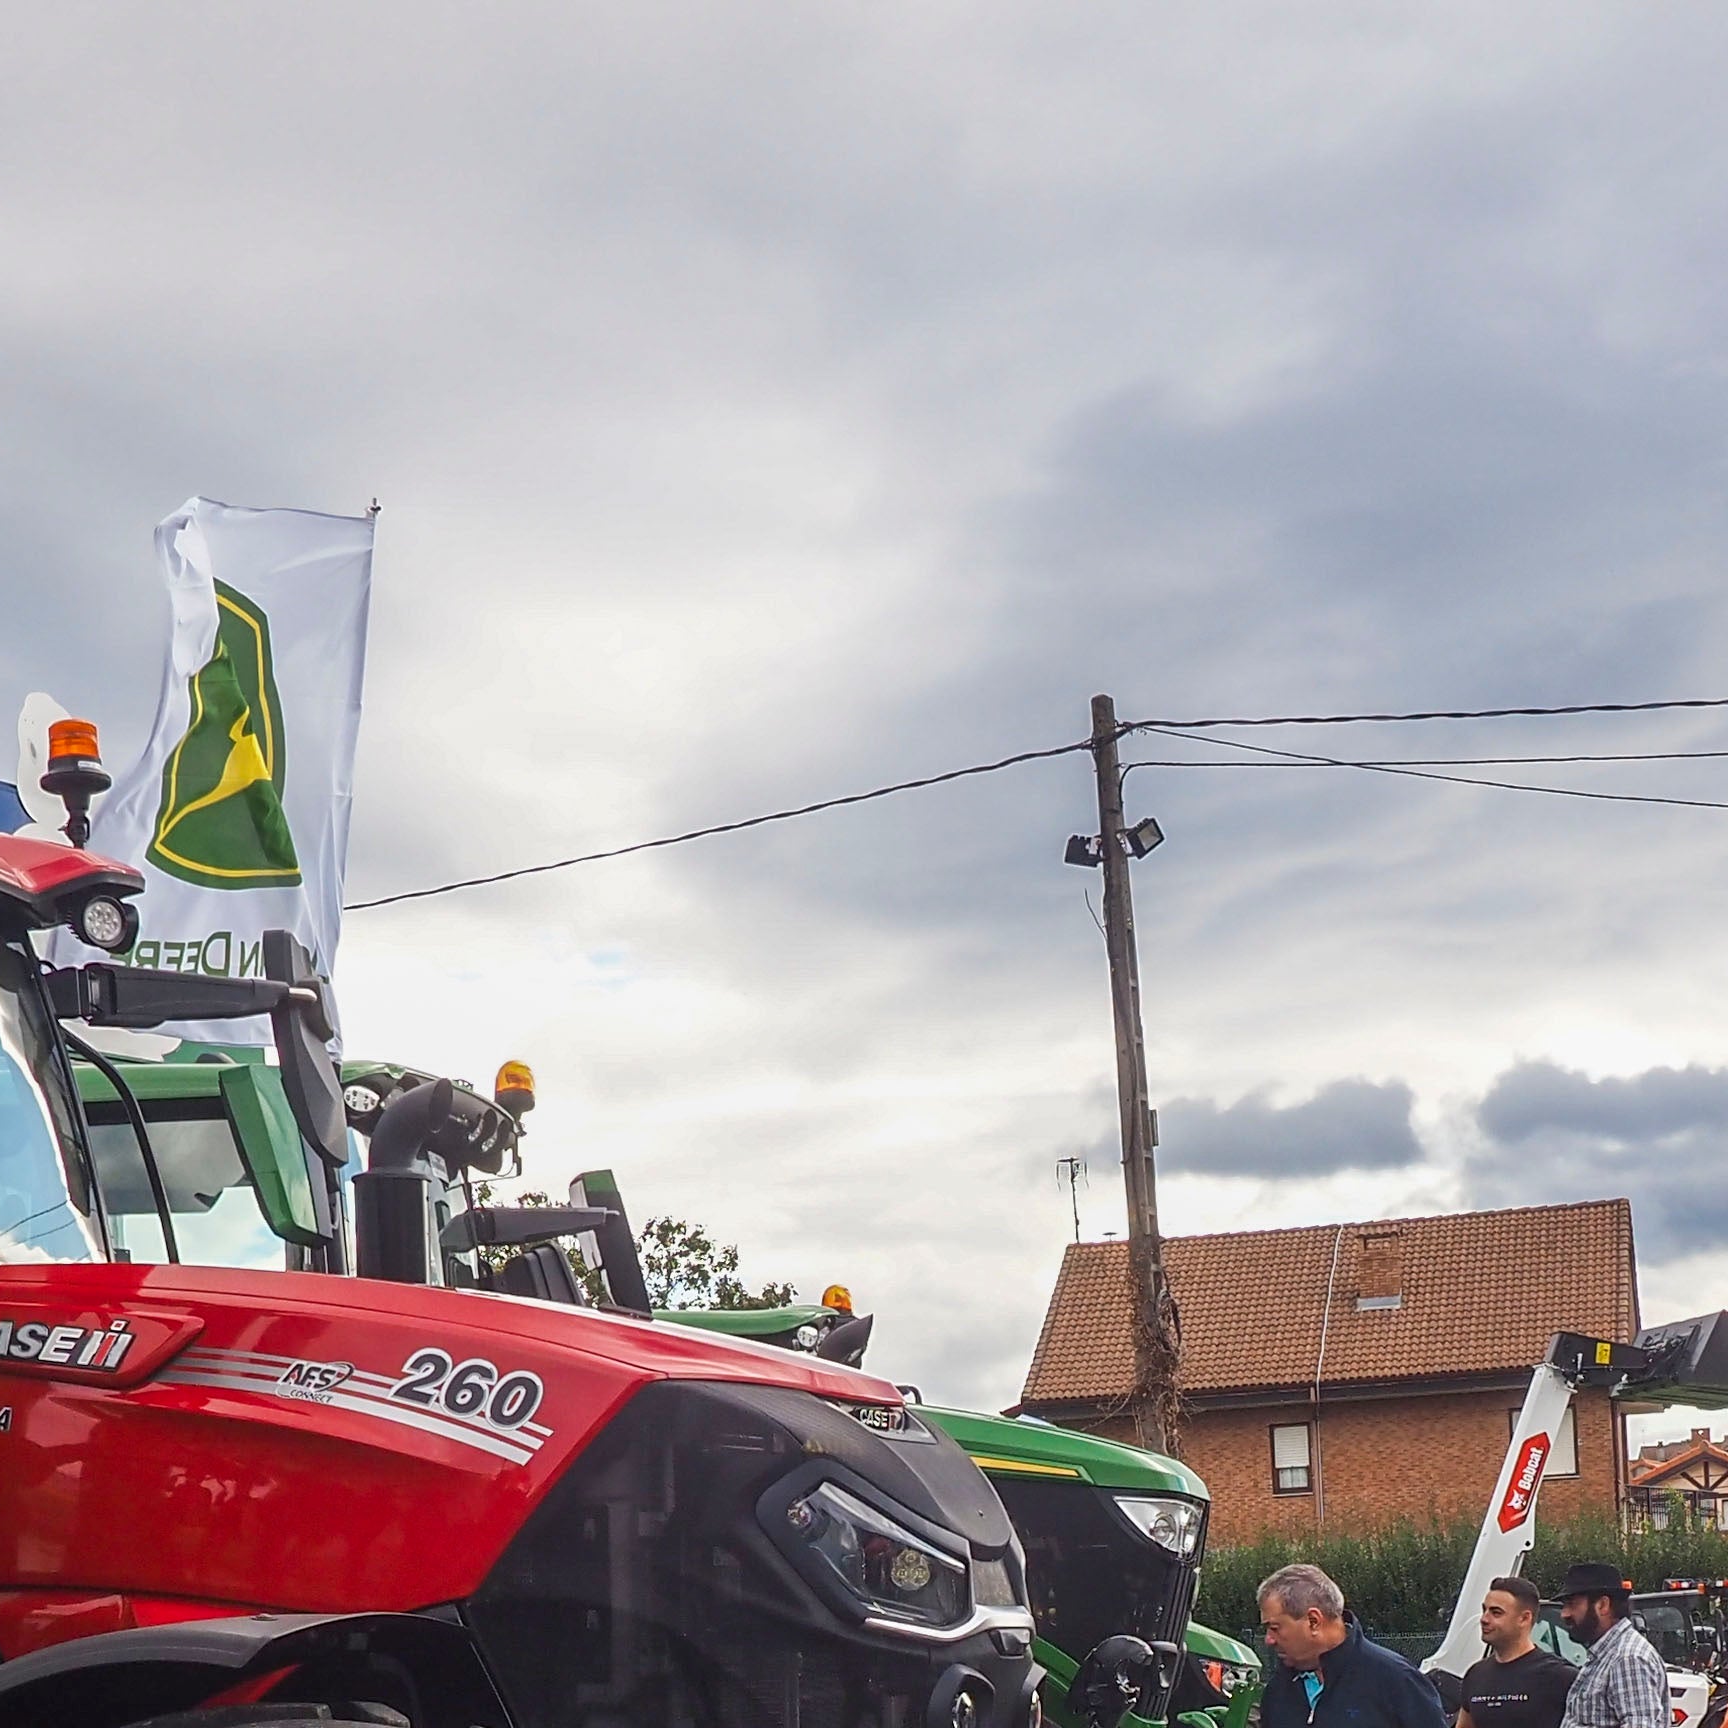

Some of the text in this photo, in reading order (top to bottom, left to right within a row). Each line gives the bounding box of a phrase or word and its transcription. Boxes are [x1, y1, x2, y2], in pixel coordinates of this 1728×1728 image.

[282, 1362, 338, 1389] AFS
[289, 1388, 334, 1404] CONNECT
[391, 1347, 545, 1433] 260
[859, 1408, 889, 1428] CASE
[1517, 1446, 1545, 1491] Bobcat
